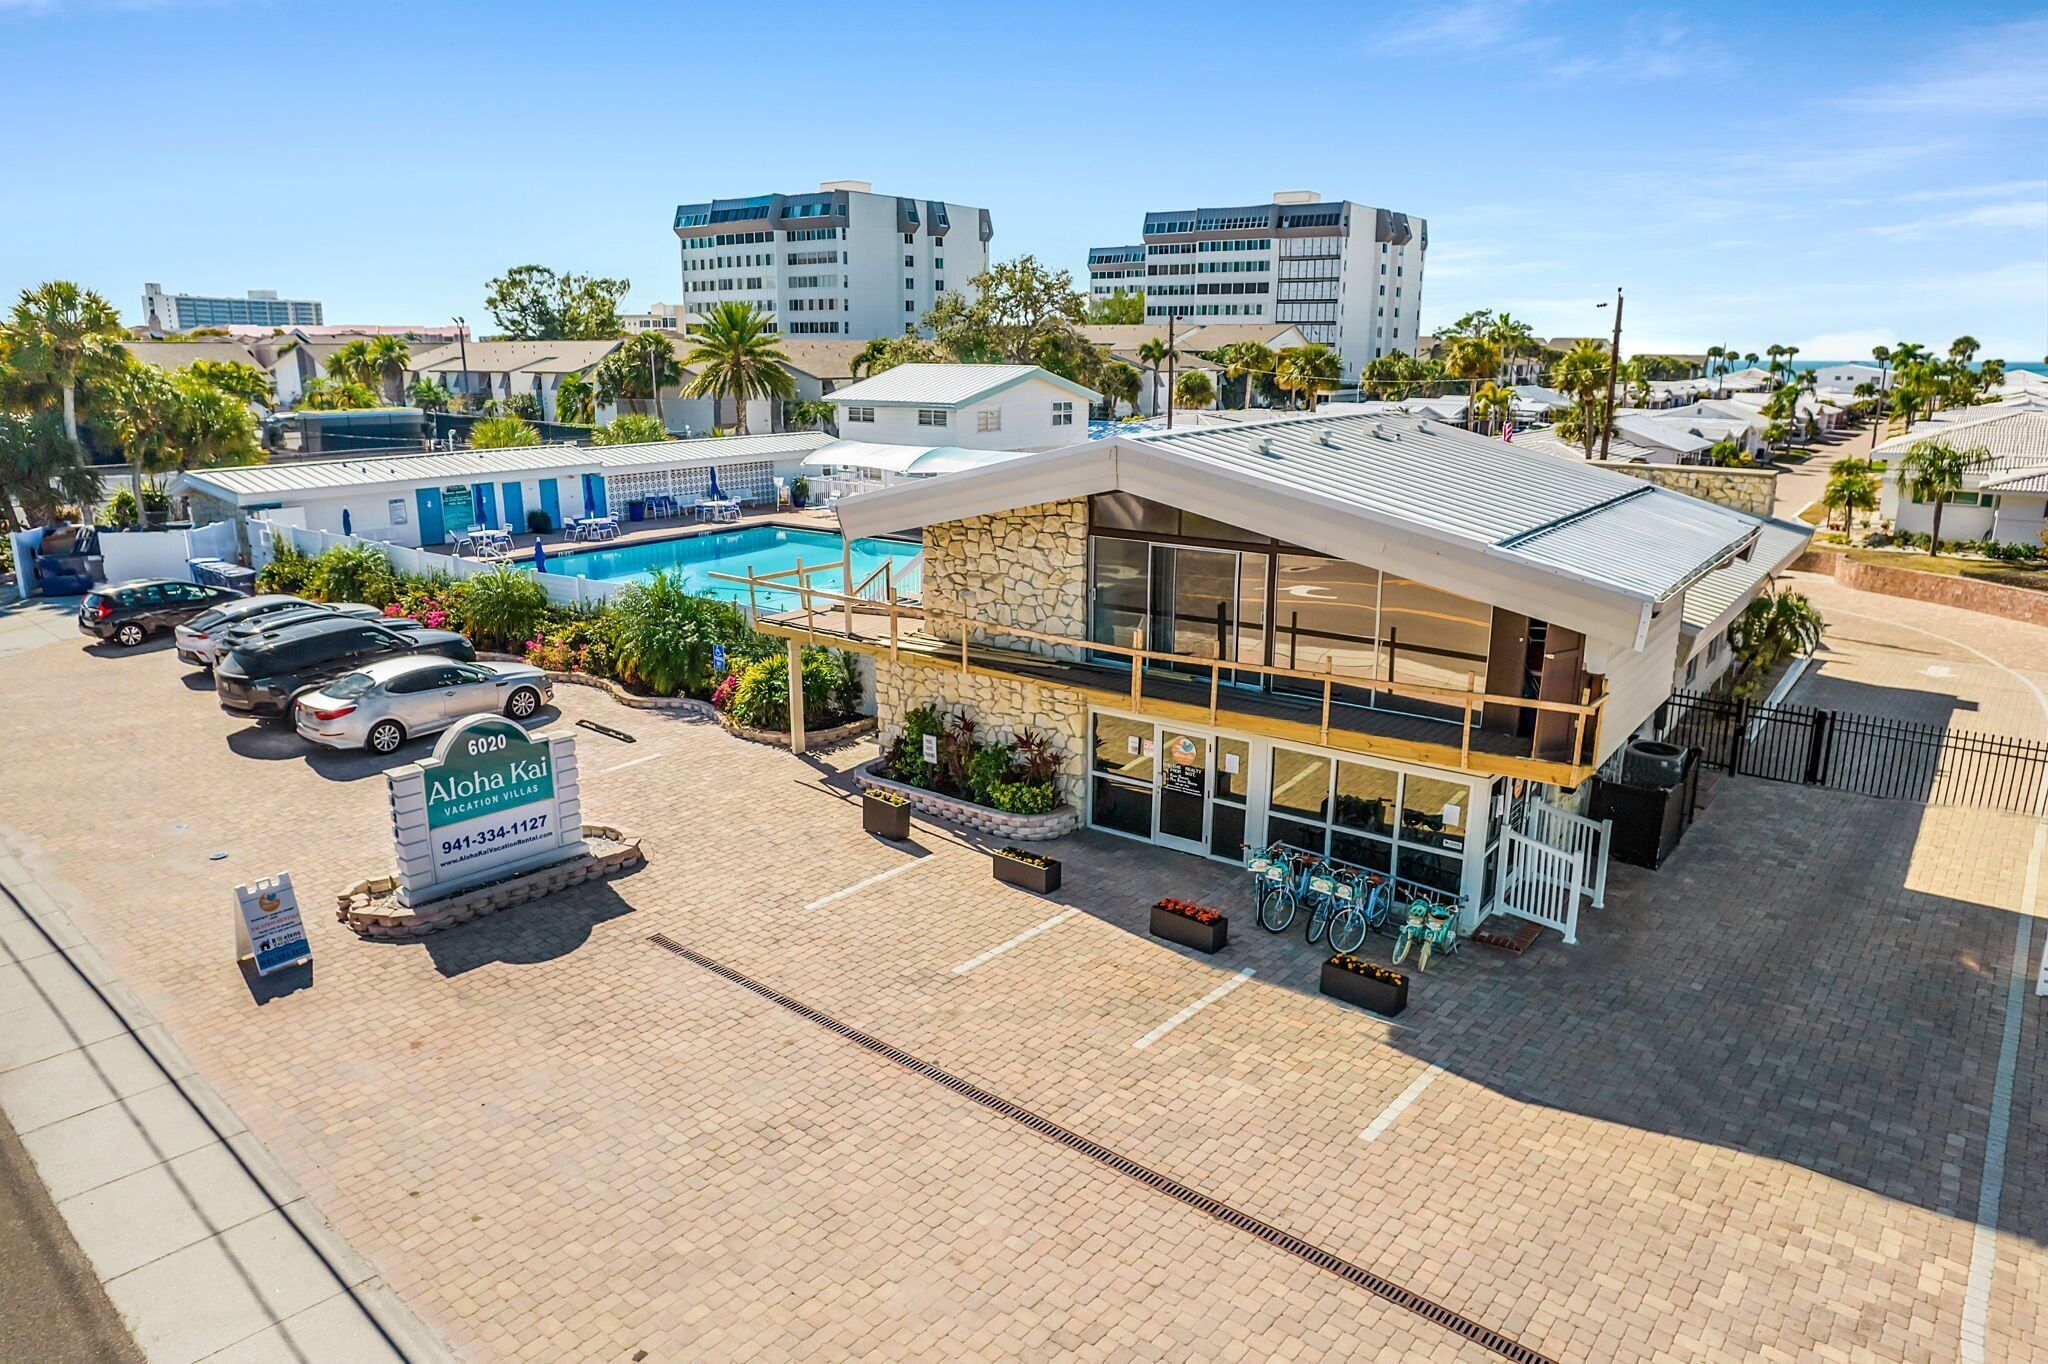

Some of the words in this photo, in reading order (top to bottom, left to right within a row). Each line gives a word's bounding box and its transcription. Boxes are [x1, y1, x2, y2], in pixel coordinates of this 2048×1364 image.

[468, 734, 507, 756] 6020
[428, 770, 505, 806] Aloha
[510, 756, 548, 785] Kai
[444, 795, 499, 816] VACATION
[503, 784, 539, 801] VILLAS
[439, 831, 553, 867] www.AlohaKaiVacationRental.com
[441, 814, 548, 855] 941-334-1127
